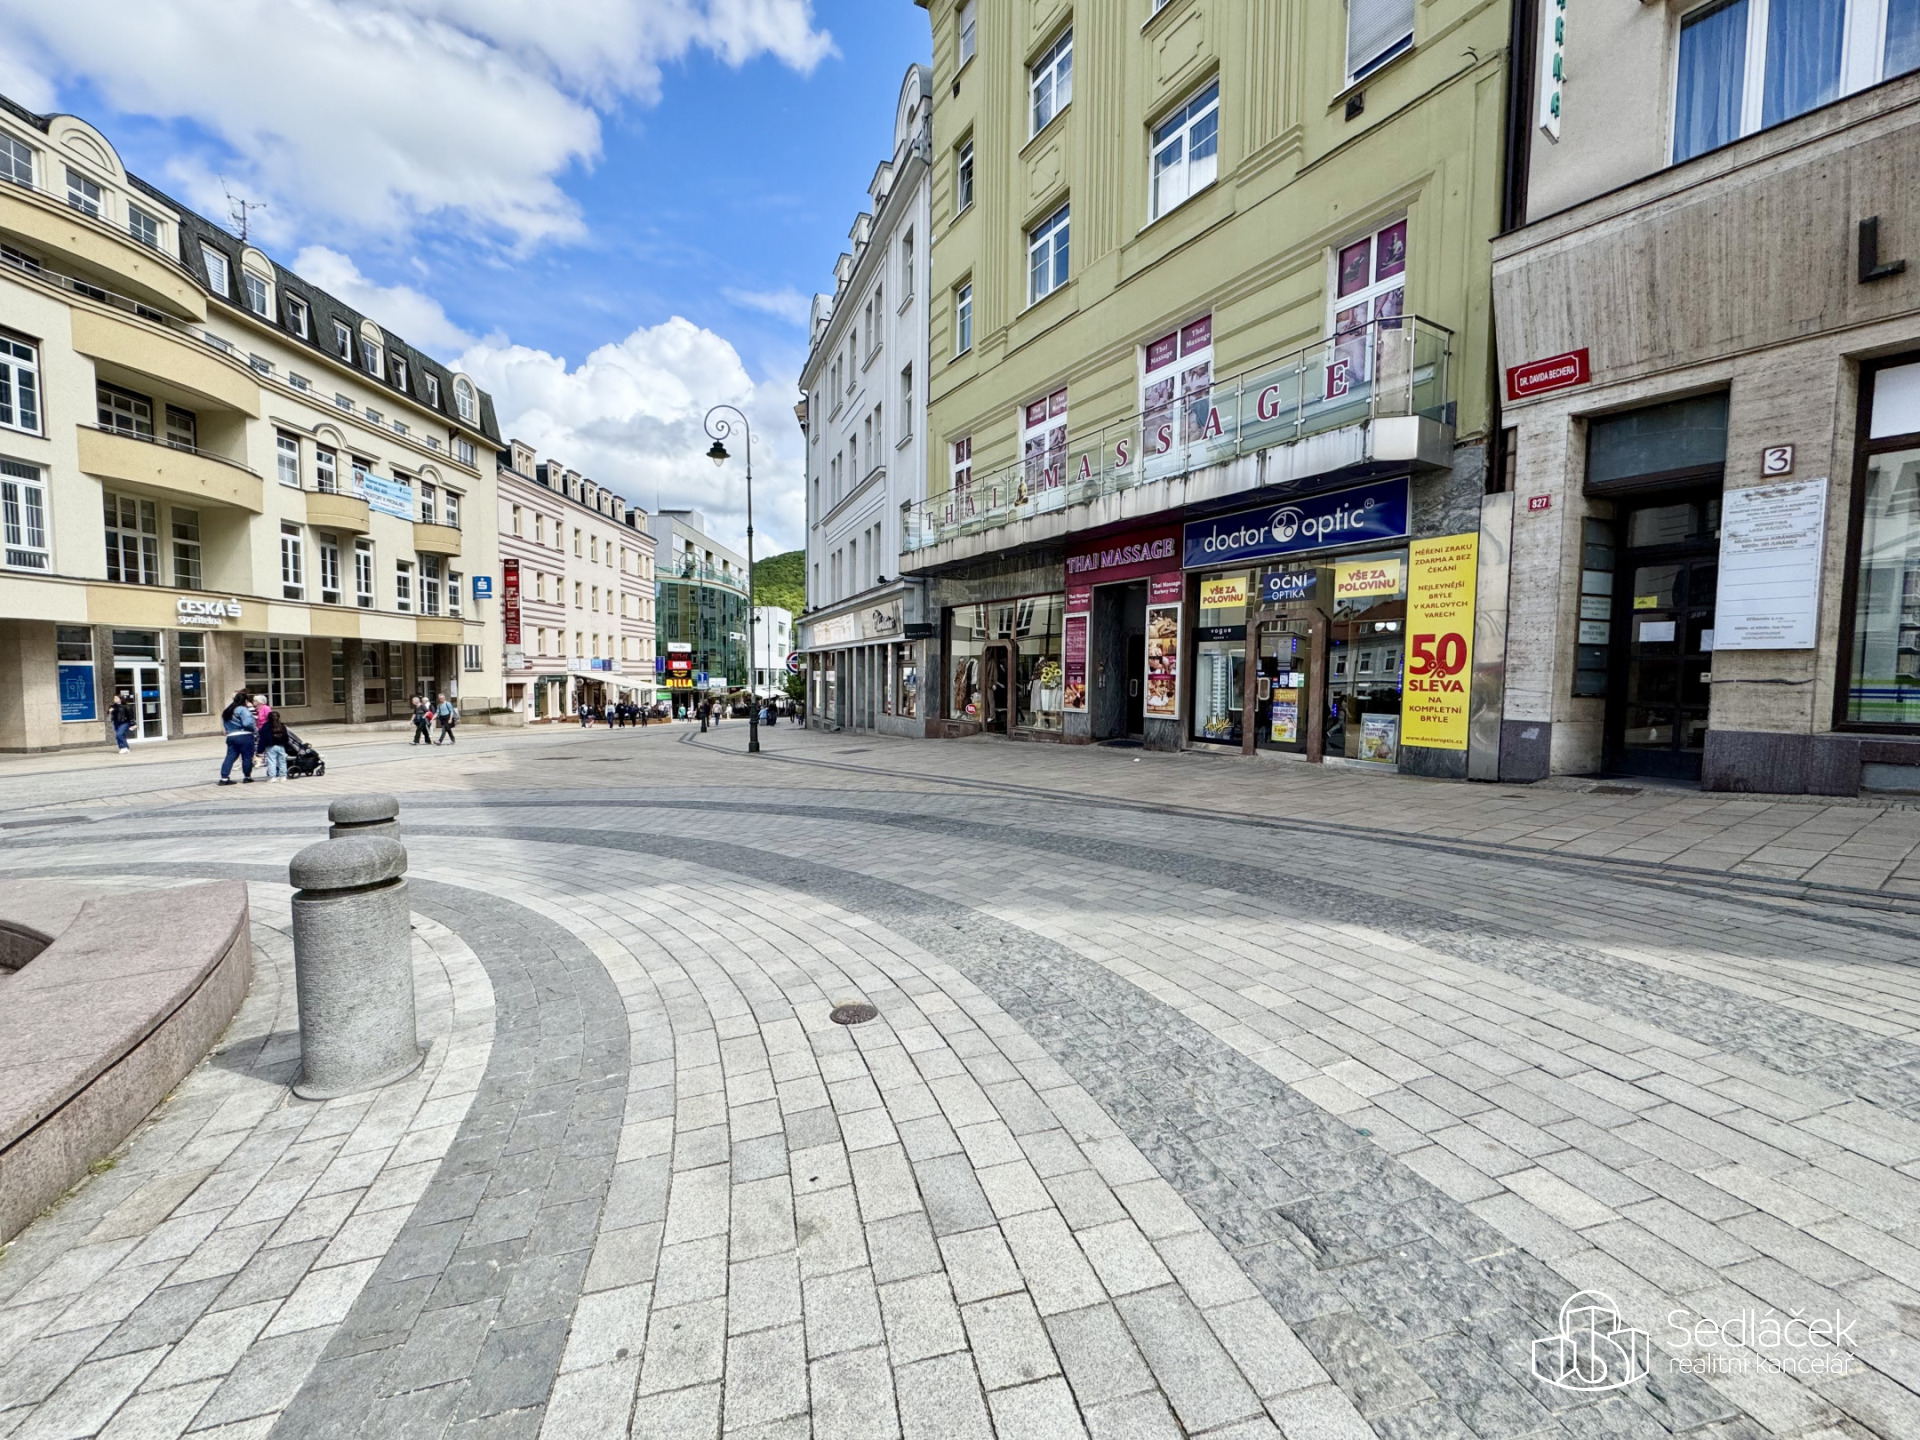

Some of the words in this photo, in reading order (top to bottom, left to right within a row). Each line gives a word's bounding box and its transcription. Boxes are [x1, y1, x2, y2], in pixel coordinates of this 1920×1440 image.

[1191, 325, 1206, 337] Thai
[1186, 333, 1211, 348] Massage
[1155, 343, 1168, 354] Thai
[1150, 351, 1173, 365] Massage
[1519, 376, 1528, 387] DR.
[1529, 372, 1549, 384] DAVIDA
[1548, 365, 1575, 380] BECHERA
[1768, 449, 1788, 471] 3
[1531, 497, 1547, 509] 827
[1203, 524, 1269, 553] doctor
[1067, 553, 1099, 574] THAI
[1101, 538, 1176, 568] MASSAGE
[1414, 546, 1443, 557] MĚŘENÍ
[1444, 543, 1473, 553] ZRAKU
[1414, 556, 1447, 566] ZDARMA
[1455, 553, 1472, 561] BEZ
[1427, 564, 1457, 574] ČEKÁNÍ
[1269, 571, 1308, 591] OČNÍ
[1347, 570, 1368, 582] VŠE
[1369, 569, 1387, 580] ZA
[1162, 581, 1181, 589] Massage
[1209, 586, 1224, 595] VŠE
[1225, 585, 1237, 594] ZA
[1337, 578, 1396, 593] POLOVINU
[1417, 581, 1465, 592] NEJLEVNĚJŠÍ
[1202, 593, 1244, 605] POLOVINU
[1271, 589, 1305, 601] OPTIKA
[1428, 592, 1453, 600] BRÝLE
[177, 596, 227, 616] ČESKÁ
[1420, 600, 1468, 610] KARLOVÝCH
[1408, 679, 1465, 693] SLEVA
[1428, 696, 1442, 704] NA
[1409, 705, 1462, 714] KOMPLETNÍ
[1420, 714, 1448, 723] BRÝLE
